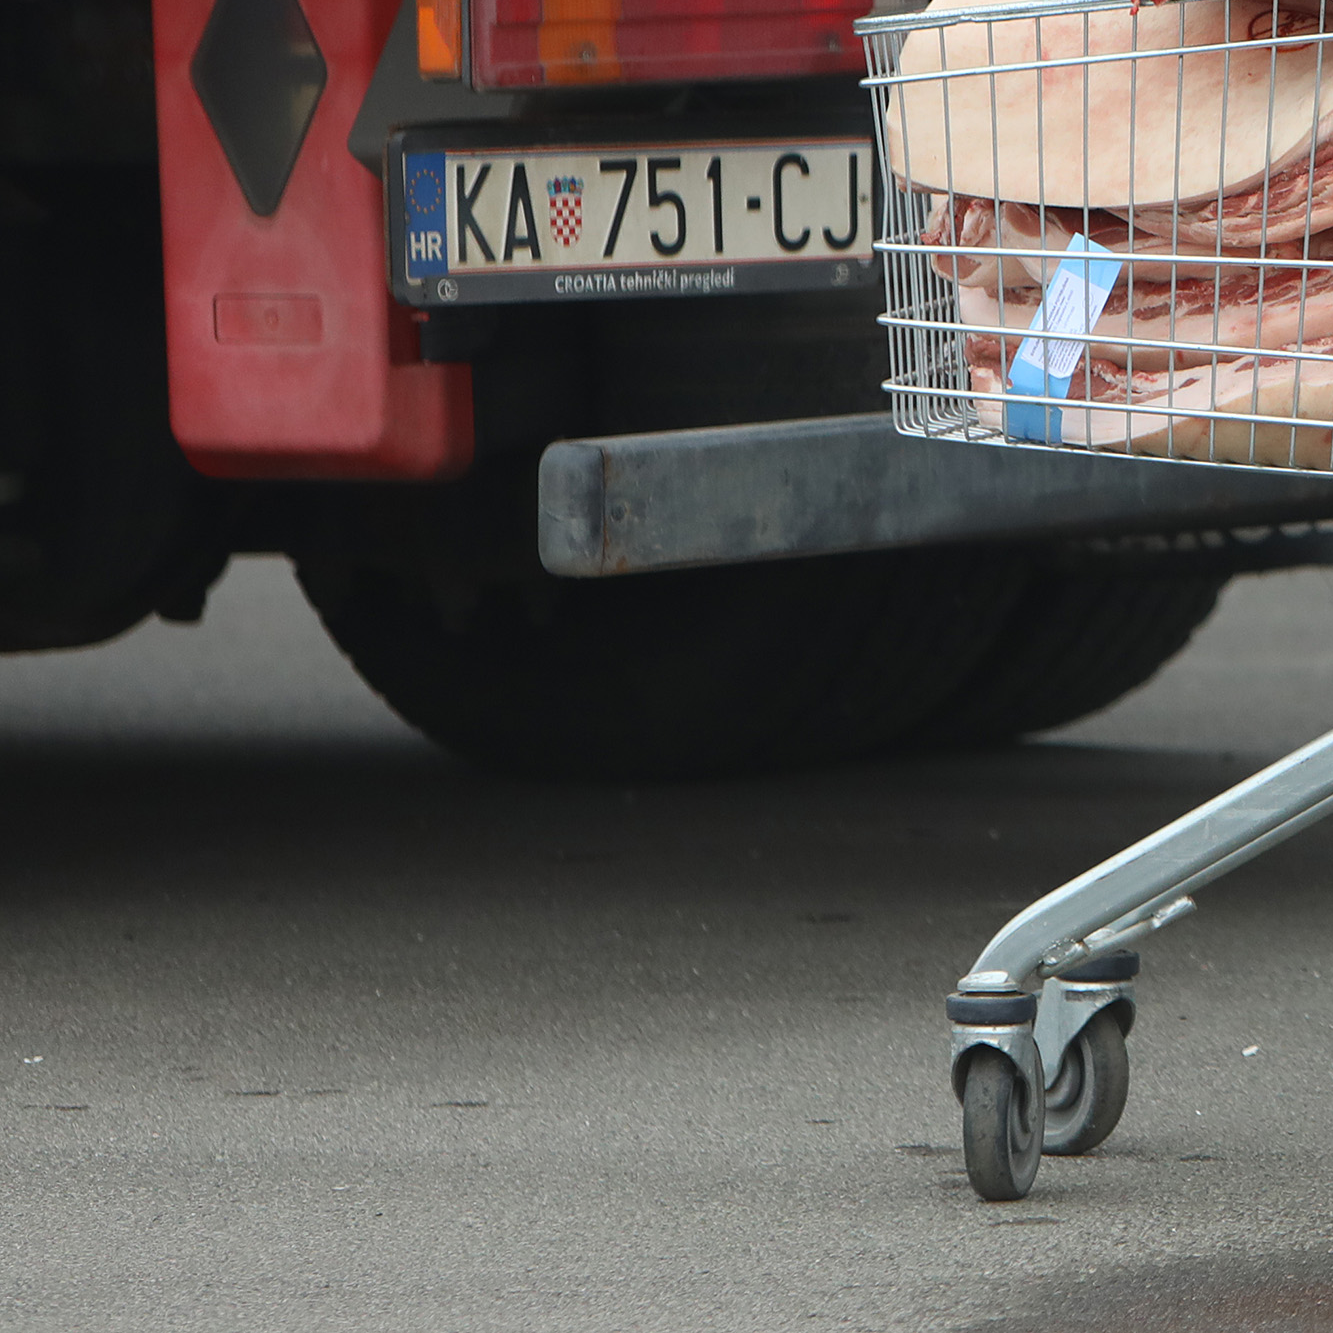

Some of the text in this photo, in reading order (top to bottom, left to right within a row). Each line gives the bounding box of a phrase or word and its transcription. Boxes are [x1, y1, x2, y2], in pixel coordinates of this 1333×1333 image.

[455, 152, 859, 264] KA 751-CJ
[410, 230, 442, 263] HR
[554, 266, 735, 294] CROATIA tehnički pregledi
